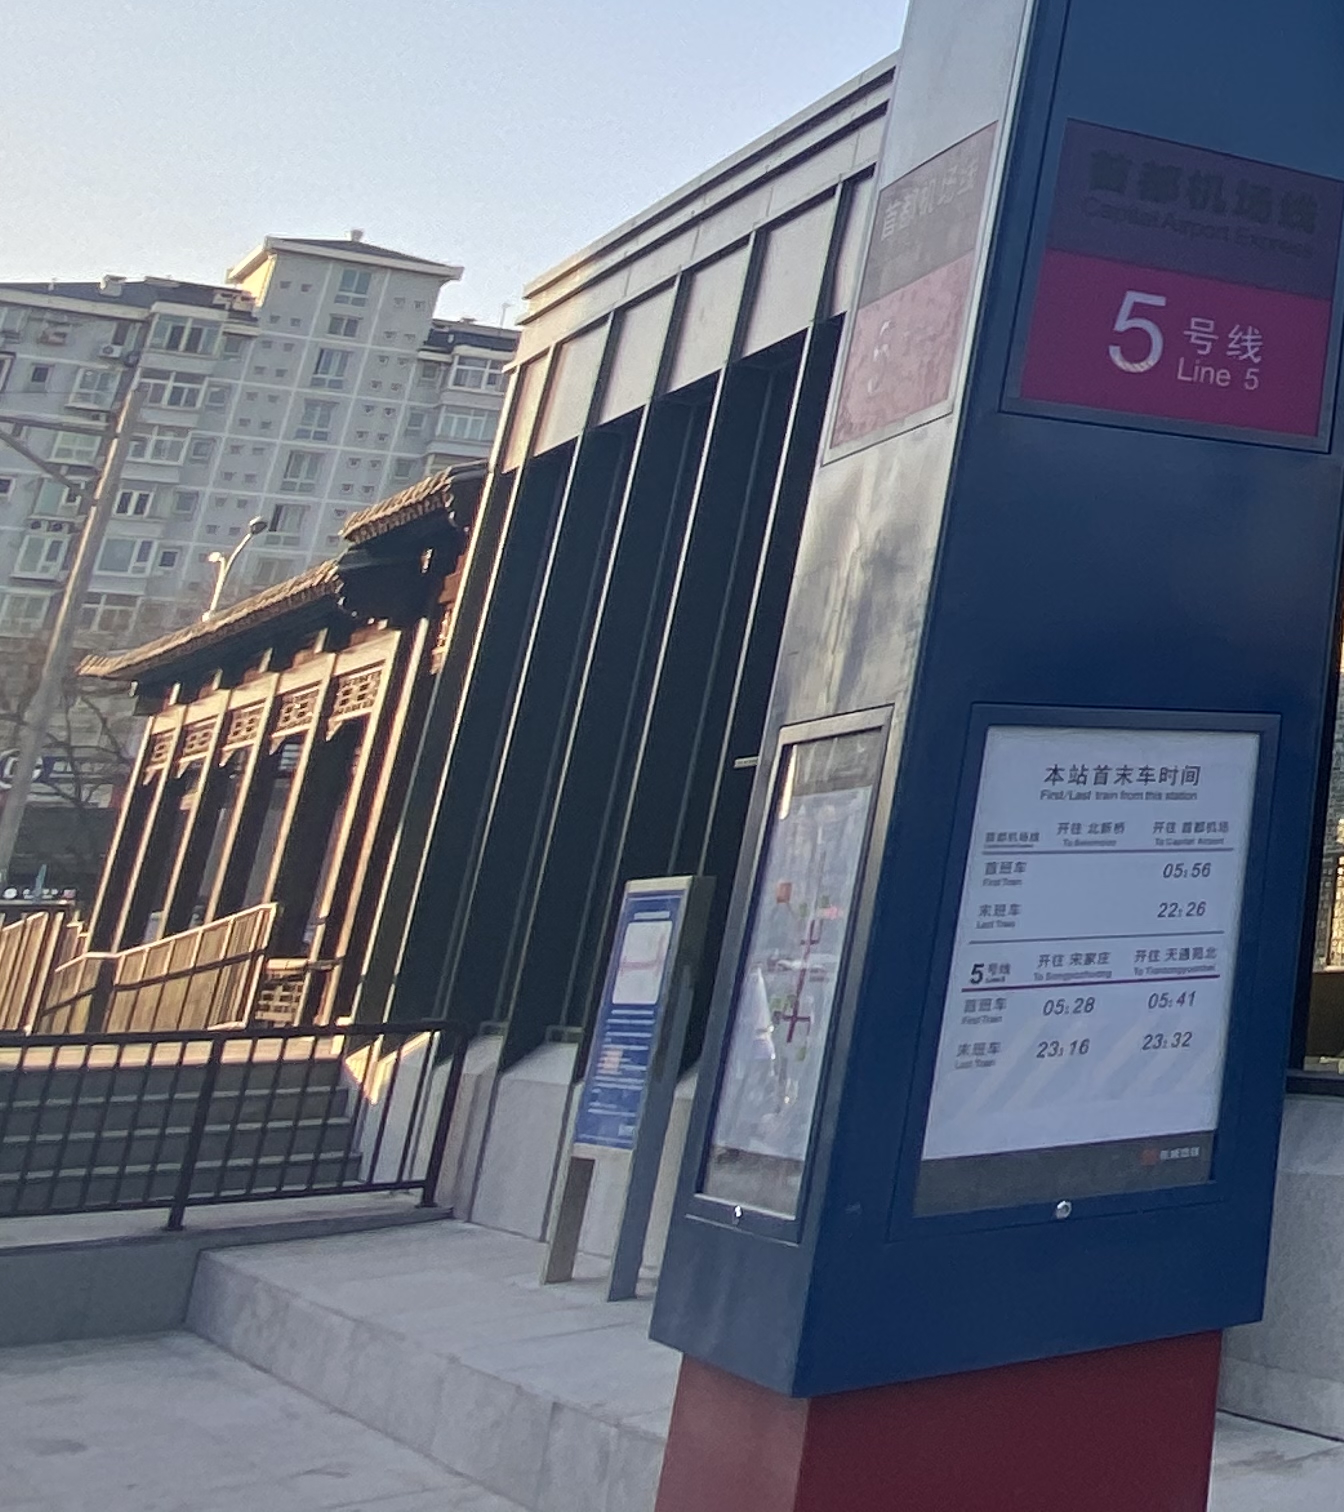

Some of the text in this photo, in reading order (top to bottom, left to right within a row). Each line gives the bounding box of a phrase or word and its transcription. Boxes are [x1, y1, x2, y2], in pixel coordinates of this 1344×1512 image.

[1108, 290, 1264, 373] 5 号线
[1176, 356, 1260, 391] Line 5
[1043, 763, 1201, 787] 本站首末车时间
[1162, 861, 1212, 879] 05:56
[1156, 901, 1207, 919] 22:26
[969, 962, 985, 985] 5
[1042, 996, 1096, 1016] 05:28
[1147, 990, 1197, 1009] 05:41
[1036, 1038, 1091, 1059] 23:16
[1141, 1031, 1193, 1051] 23:32
